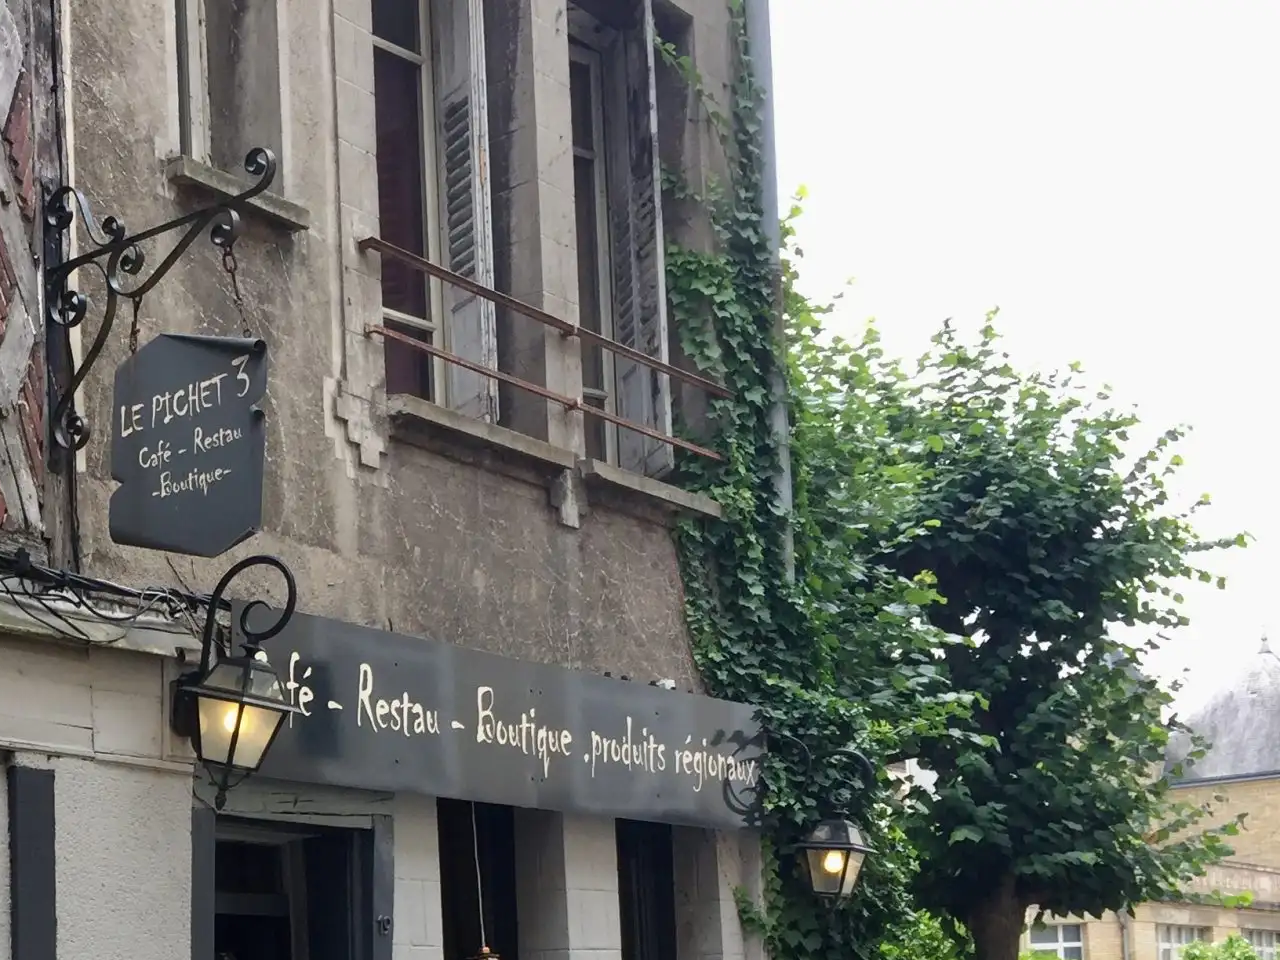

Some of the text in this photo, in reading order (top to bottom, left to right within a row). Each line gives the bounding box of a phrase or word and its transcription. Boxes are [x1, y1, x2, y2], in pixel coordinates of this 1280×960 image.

[120, 354, 250, 437] LE PICHET 3
[139, 440, 172, 469] Café
[194, 426, 243, 455] Restau
[356, 662, 441, 738] Restau
[476, 686, 573, 778] Boutique
[674, 734, 757, 792] régionaux
